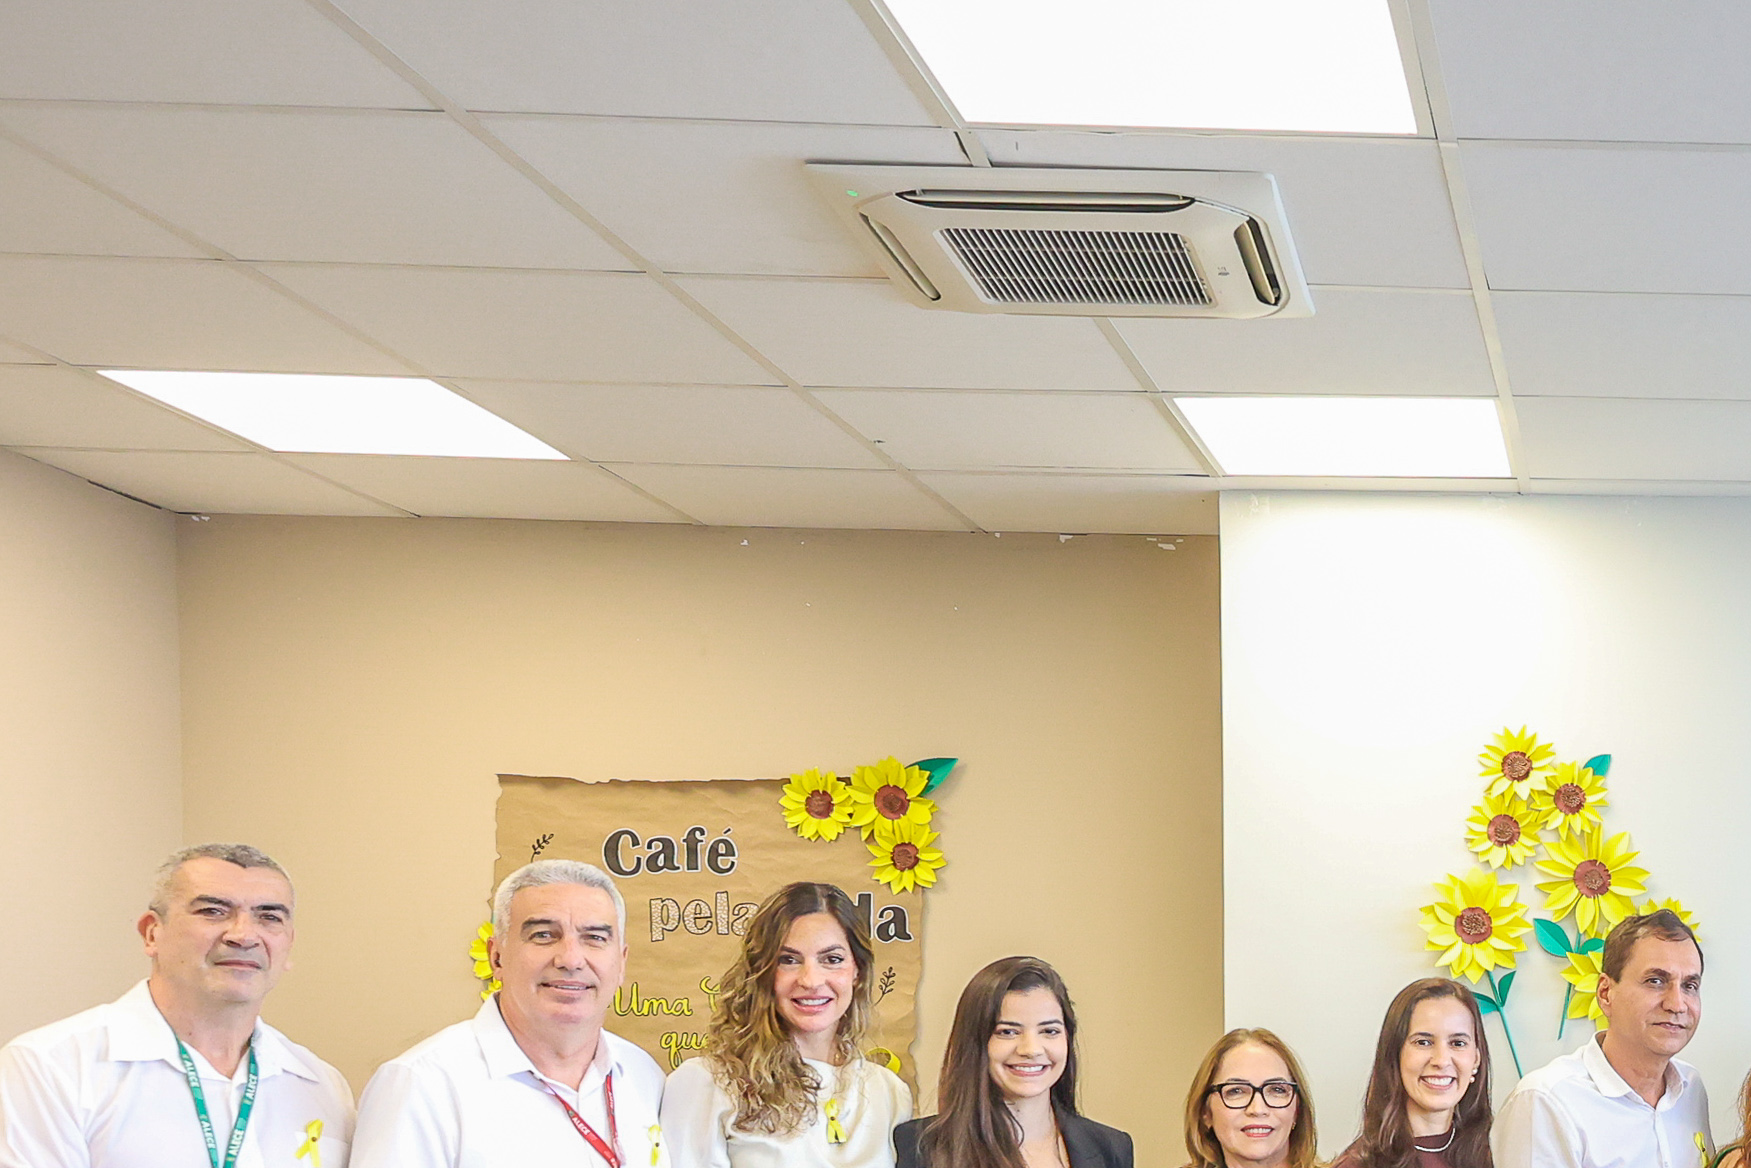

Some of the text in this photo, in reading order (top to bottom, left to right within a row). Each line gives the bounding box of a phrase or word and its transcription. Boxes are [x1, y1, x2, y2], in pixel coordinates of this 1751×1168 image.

[602, 826, 739, 878] Café
[649, 890, 759, 942] pela
[613, 981, 693, 1016] Uma
[183, 1060, 200, 1087] ALECE
[245, 1073, 258, 1099] ALECE
[201, 1120, 216, 1149] ALECE
[572, 1117, 591, 1136] ALECE
[228, 1129, 245, 1156] ALECE
